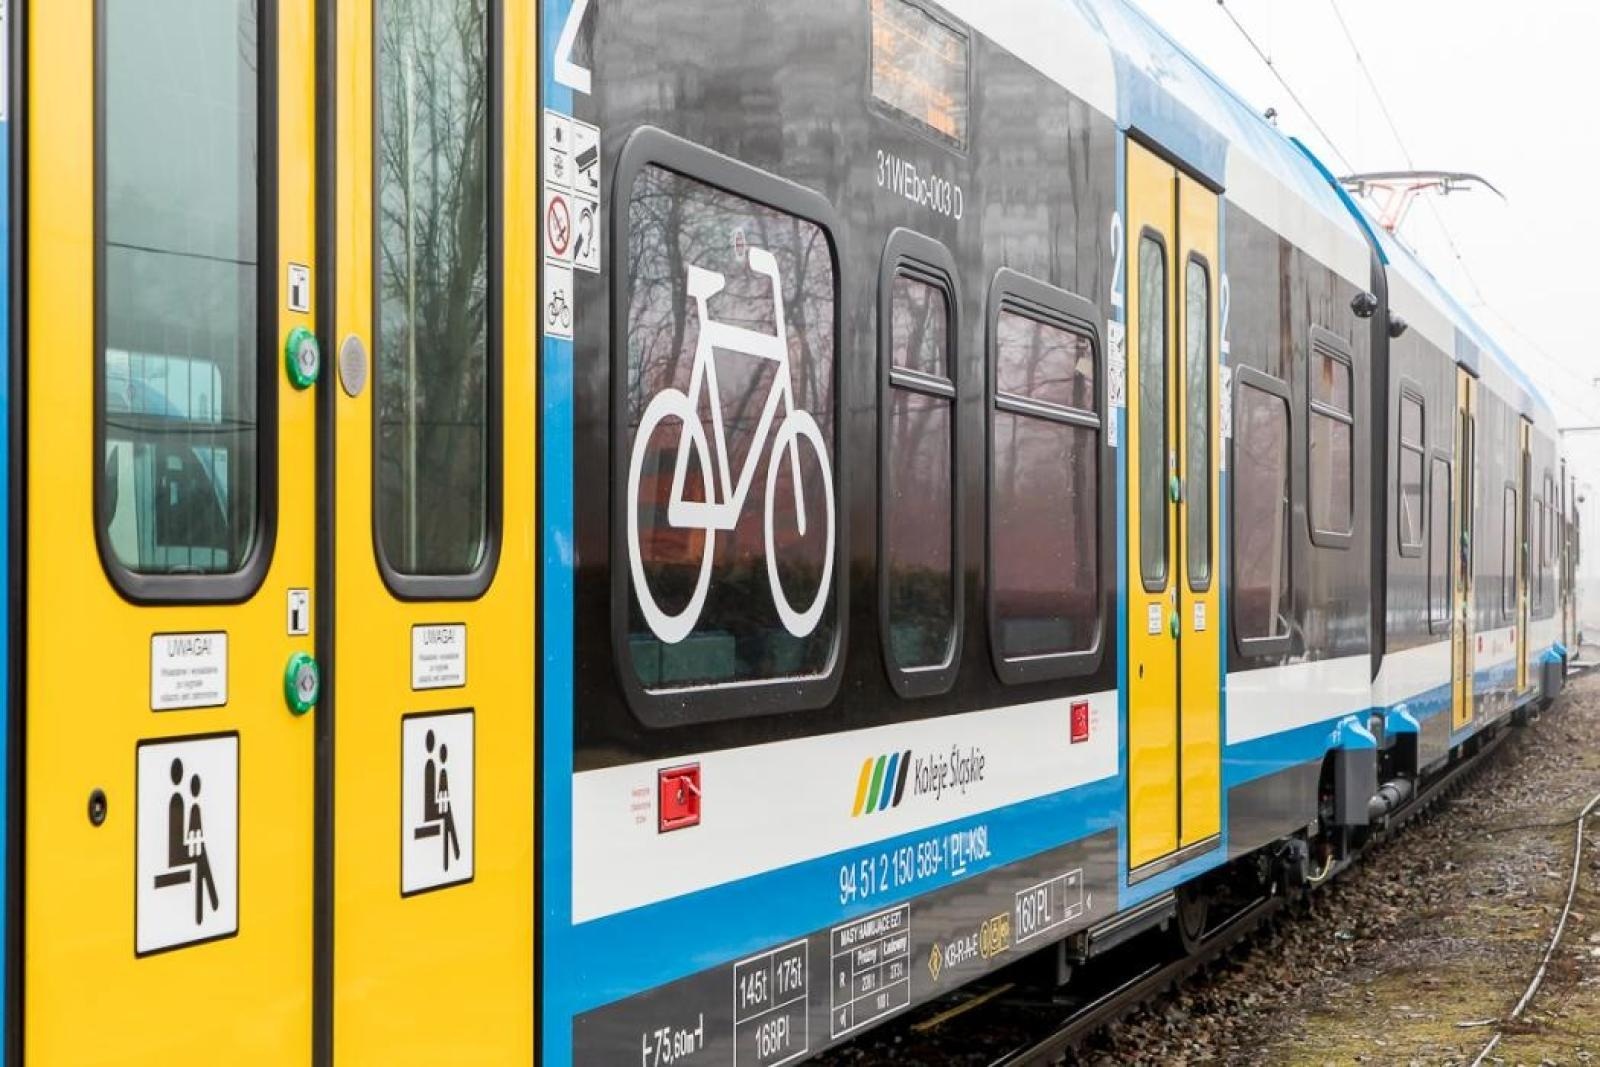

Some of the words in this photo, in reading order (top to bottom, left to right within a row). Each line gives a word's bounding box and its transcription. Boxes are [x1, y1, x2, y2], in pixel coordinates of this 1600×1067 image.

[877, 149, 951, 216] 31WEbc-003
[953, 184, 963, 221] D
[1111, 211, 1124, 306] 2
[1221, 272, 1230, 354] 2
[167, 637, 213, 657] UWAGA!
[423, 628, 457, 646] UWAGA!
[913, 754, 949, 801] Koleje
[949, 743, 985, 795] Śląskie
[839, 863, 856, 905] 94
[860, 857, 875, 898] 51
[879, 853, 888, 891] 2
[892, 846, 914, 886] 150
[739, 968, 768, 1009] 145t
[776, 956, 803, 995] 175t
